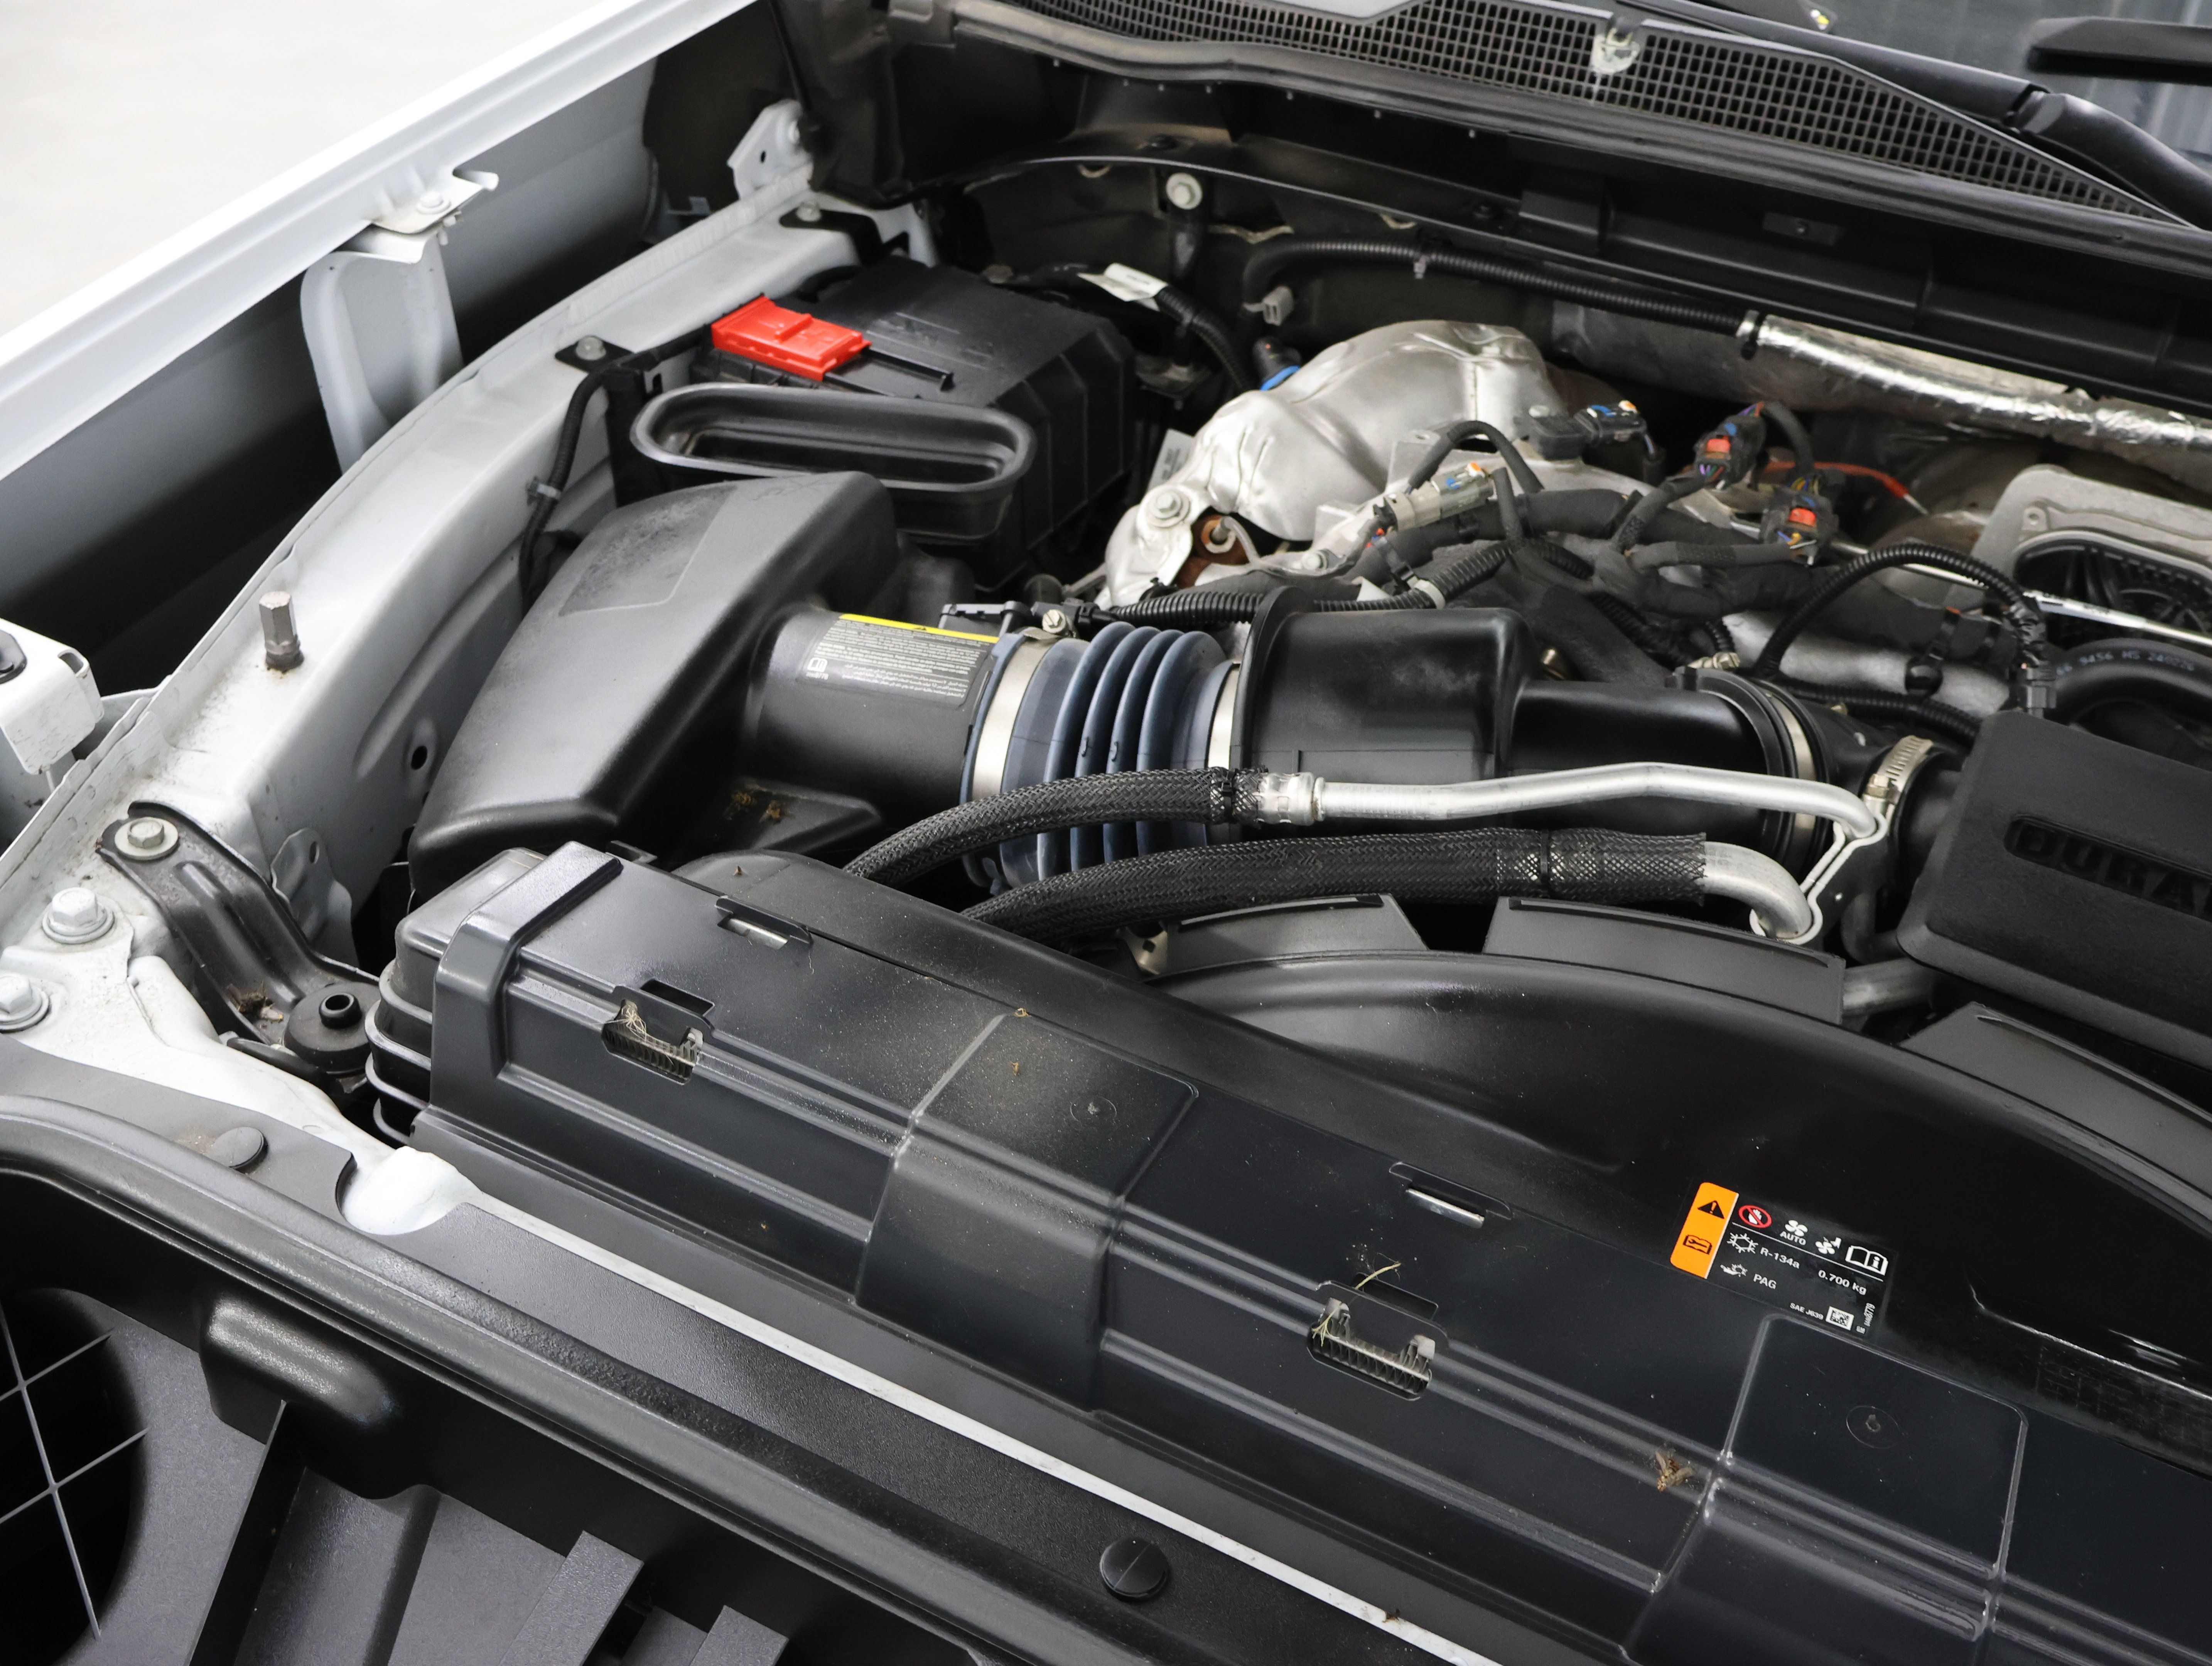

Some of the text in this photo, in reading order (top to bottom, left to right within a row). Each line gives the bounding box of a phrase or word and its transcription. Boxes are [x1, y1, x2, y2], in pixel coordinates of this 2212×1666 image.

[2011, 821, 2212, 921] DURA
[1780, 1231, 1806, 1246] AUTO
[1760, 1247, 1800, 1269] R-134a
[1753, 1273, 1777, 1290] PAG
[1818, 1270, 1867, 1295] 0.700 kg
[1790, 1302, 1805, 1313] SAE
